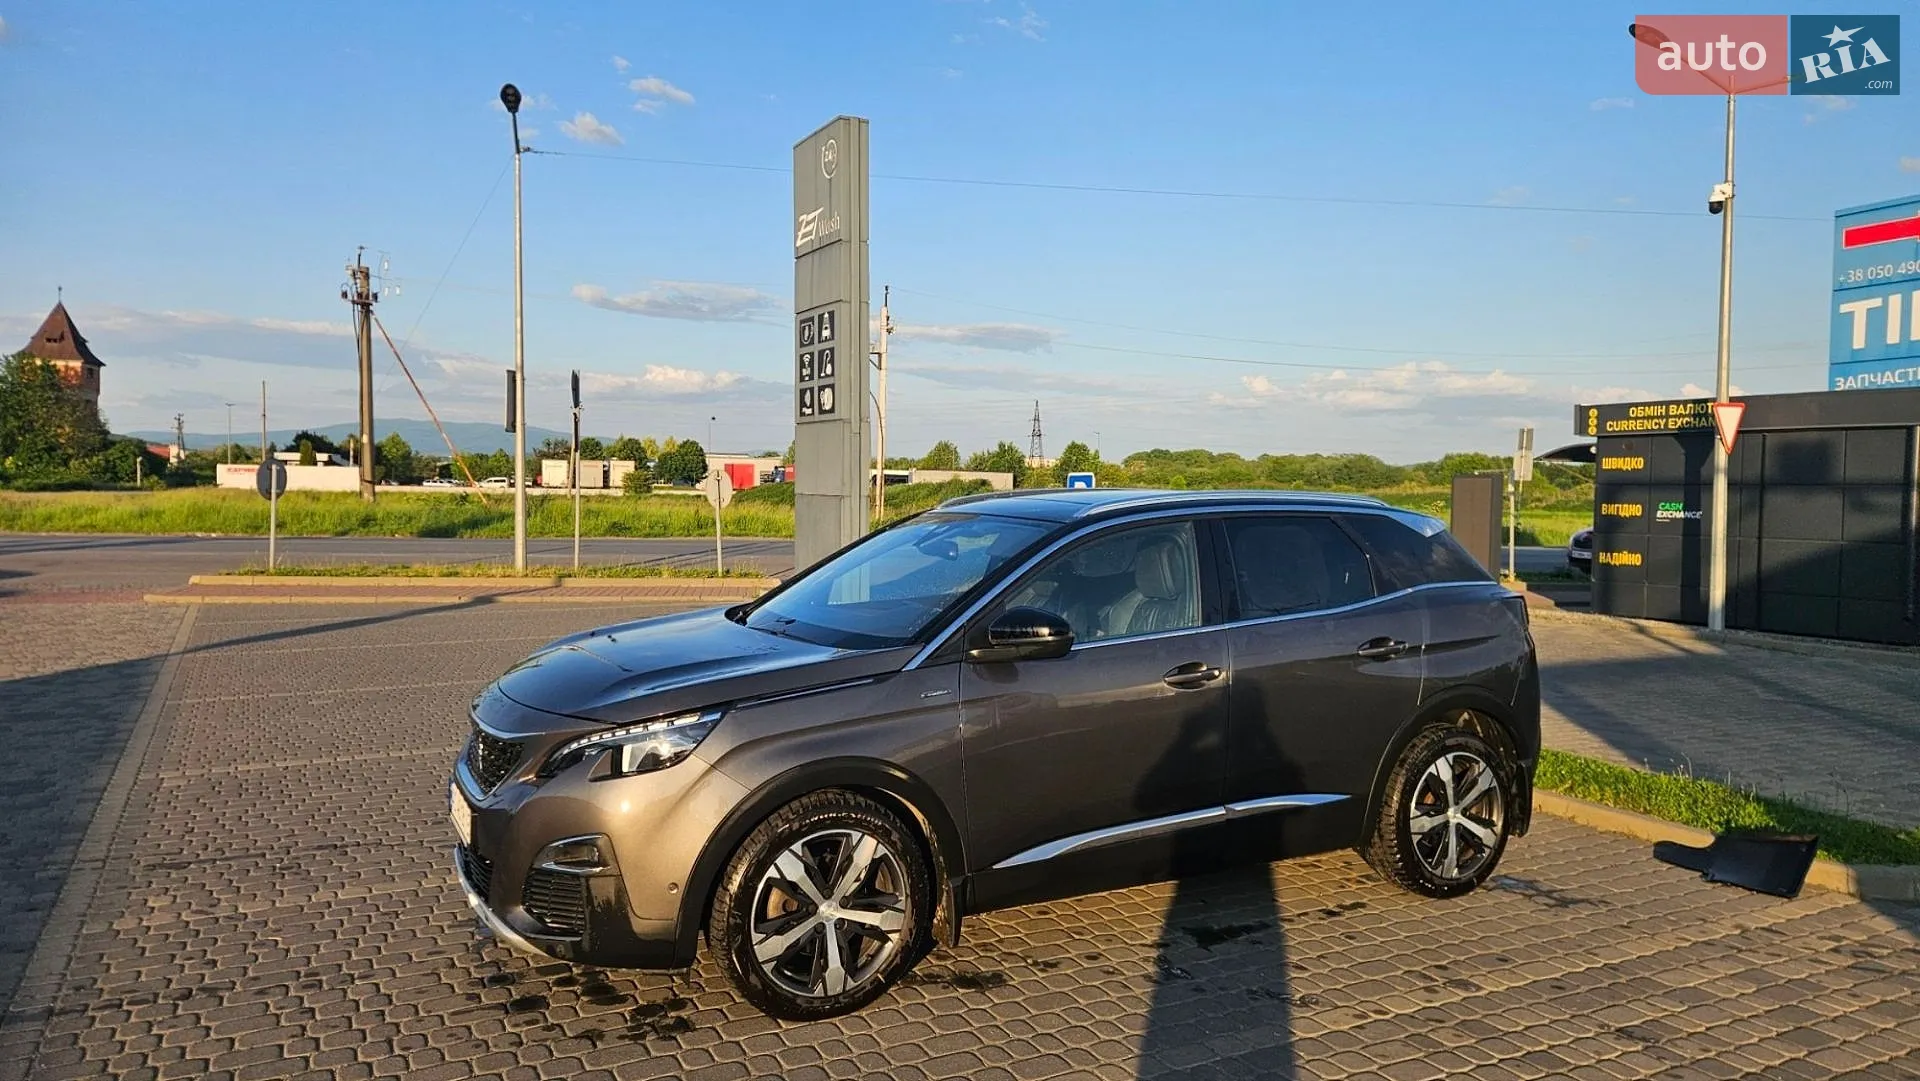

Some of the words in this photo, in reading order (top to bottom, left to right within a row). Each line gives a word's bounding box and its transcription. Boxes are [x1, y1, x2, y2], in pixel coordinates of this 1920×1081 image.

[1838, 269, 1863, 282] +38
[1867, 265, 1893, 280] 050
[1629, 406, 1666, 417] ОБМІН
[1606, 419, 1666, 431] CURRENCY
[1668, 417, 1715, 429] EXCHAN
[1602, 457, 1644, 471] ШВИДКО
[1599, 551, 1642, 567] НАДІЙНО
